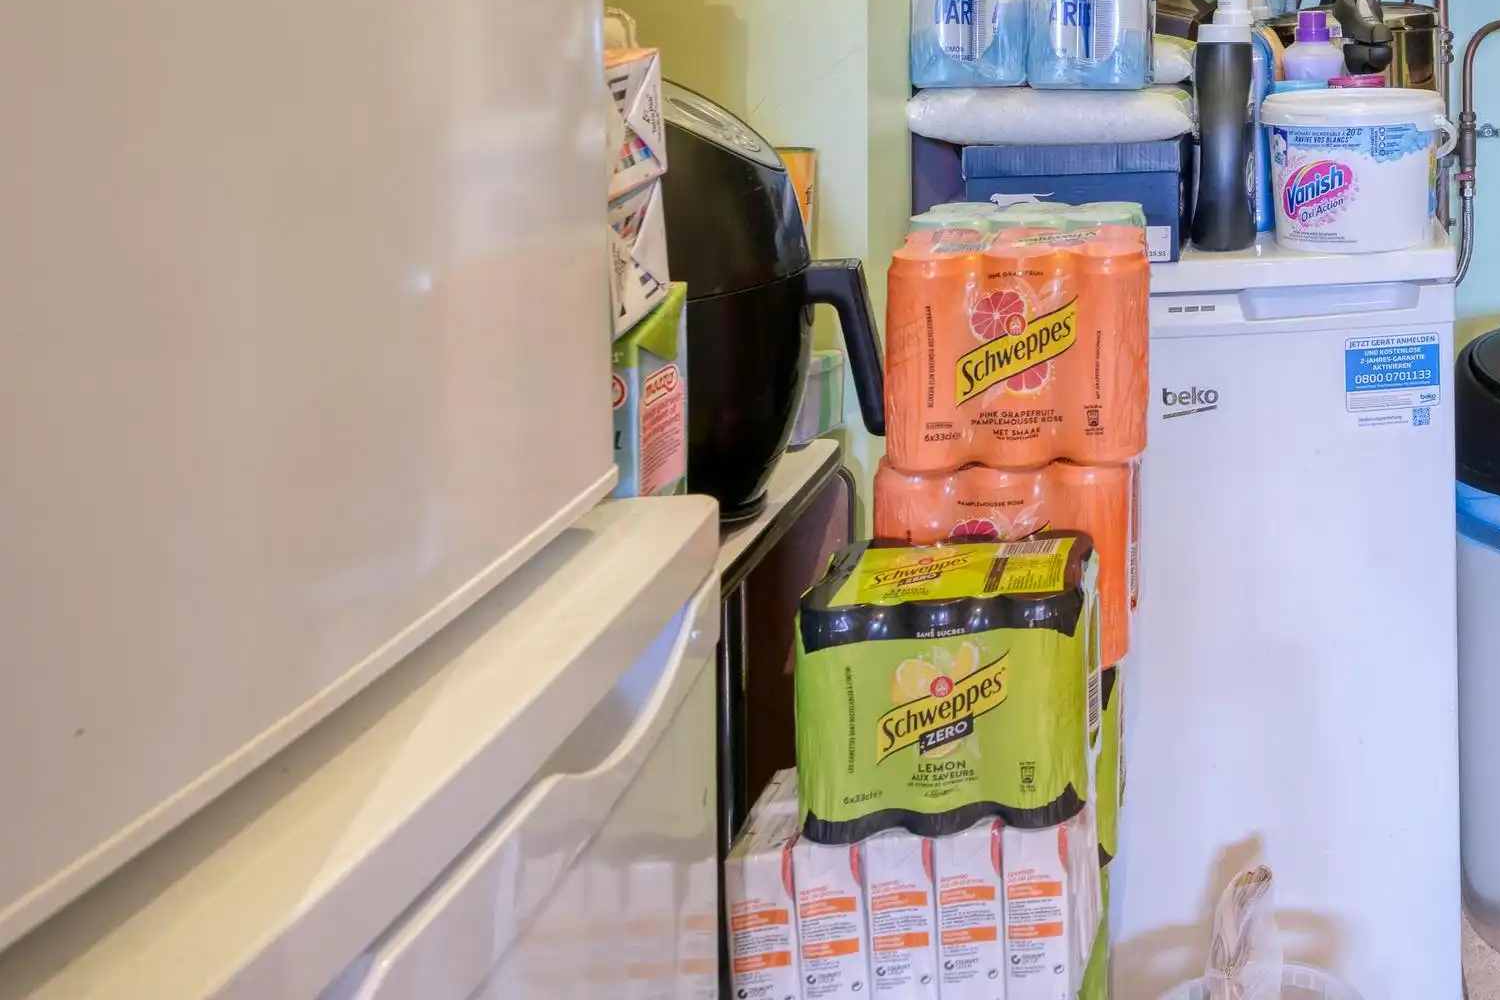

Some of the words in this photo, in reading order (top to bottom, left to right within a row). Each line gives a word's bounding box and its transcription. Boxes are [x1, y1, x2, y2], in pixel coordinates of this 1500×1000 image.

[1287, 164, 1344, 214] Vanish
[1302, 209, 1315, 222] Oxi
[1316, 198, 1344, 216] Action
[1349, 340, 1370, 348] JETZT
[1396, 335, 1435, 344] ANMELDEN
[962, 315, 1072, 396] Schweppes
[1360, 354, 1425, 364] 2-JAHRES-GARANTIE
[1355, 373, 1384, 384] 0800
[1385, 370, 1431, 382] 0701133
[1162, 386, 1219, 406] beko
[1420, 392, 1436, 400] beko
[971, 416, 1038, 425] PAMPLEMOUSSE
[1001, 409, 1055, 418] GRAPEFRUIT
[874, 556, 969, 584] Schweppes
[882, 671, 1002, 752] Schweppes
[925, 721, 968, 746] ZERO
[918, 760, 966, 773] LEMON
[911, 773, 929, 782] AUX
[932, 769, 975, 781] SAVEURS
